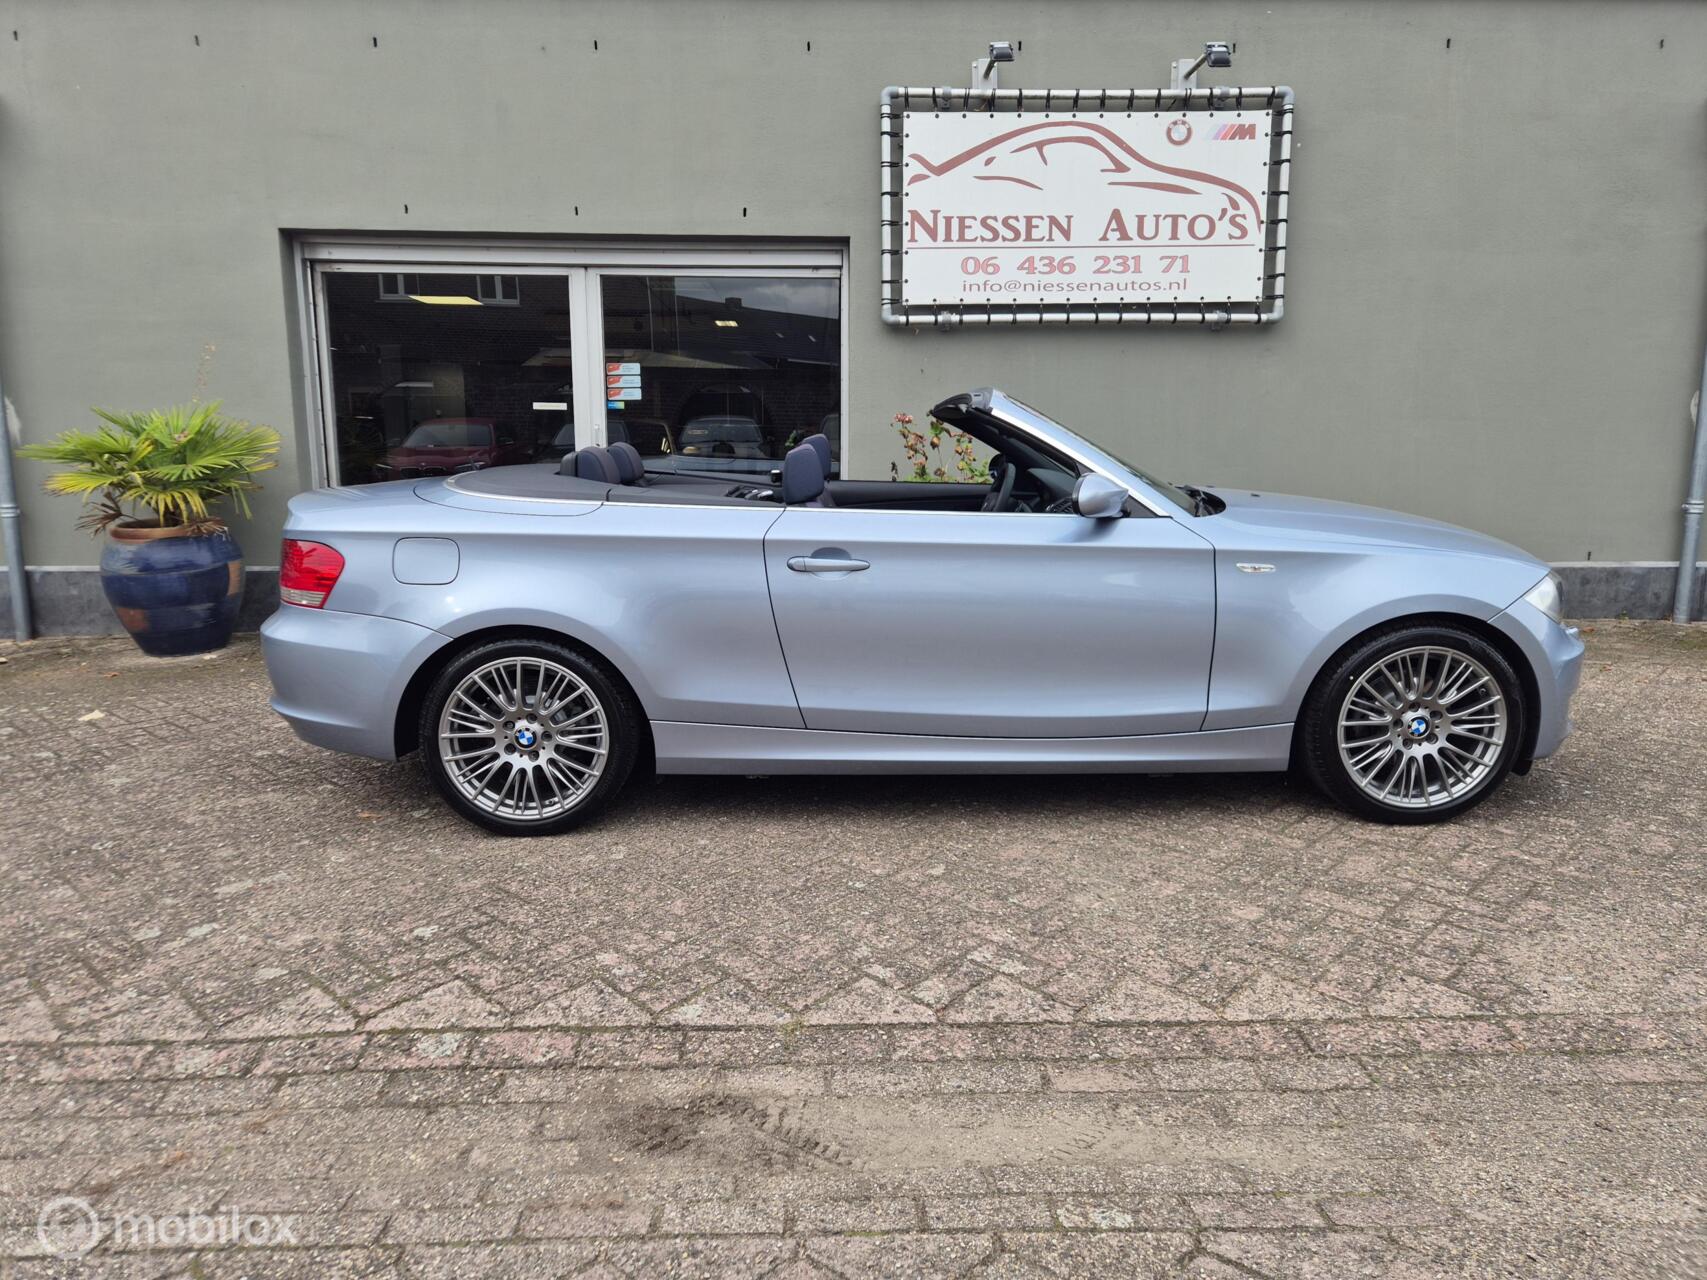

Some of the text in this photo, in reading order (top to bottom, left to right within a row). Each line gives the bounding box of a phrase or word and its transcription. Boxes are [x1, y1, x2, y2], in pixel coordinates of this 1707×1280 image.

[907, 208, 1249, 243] NIESSEN AUTO'S
[960, 254, 1191, 275] 06 436 231 71
[962, 278, 1188, 292] info@niessenautos.nl
